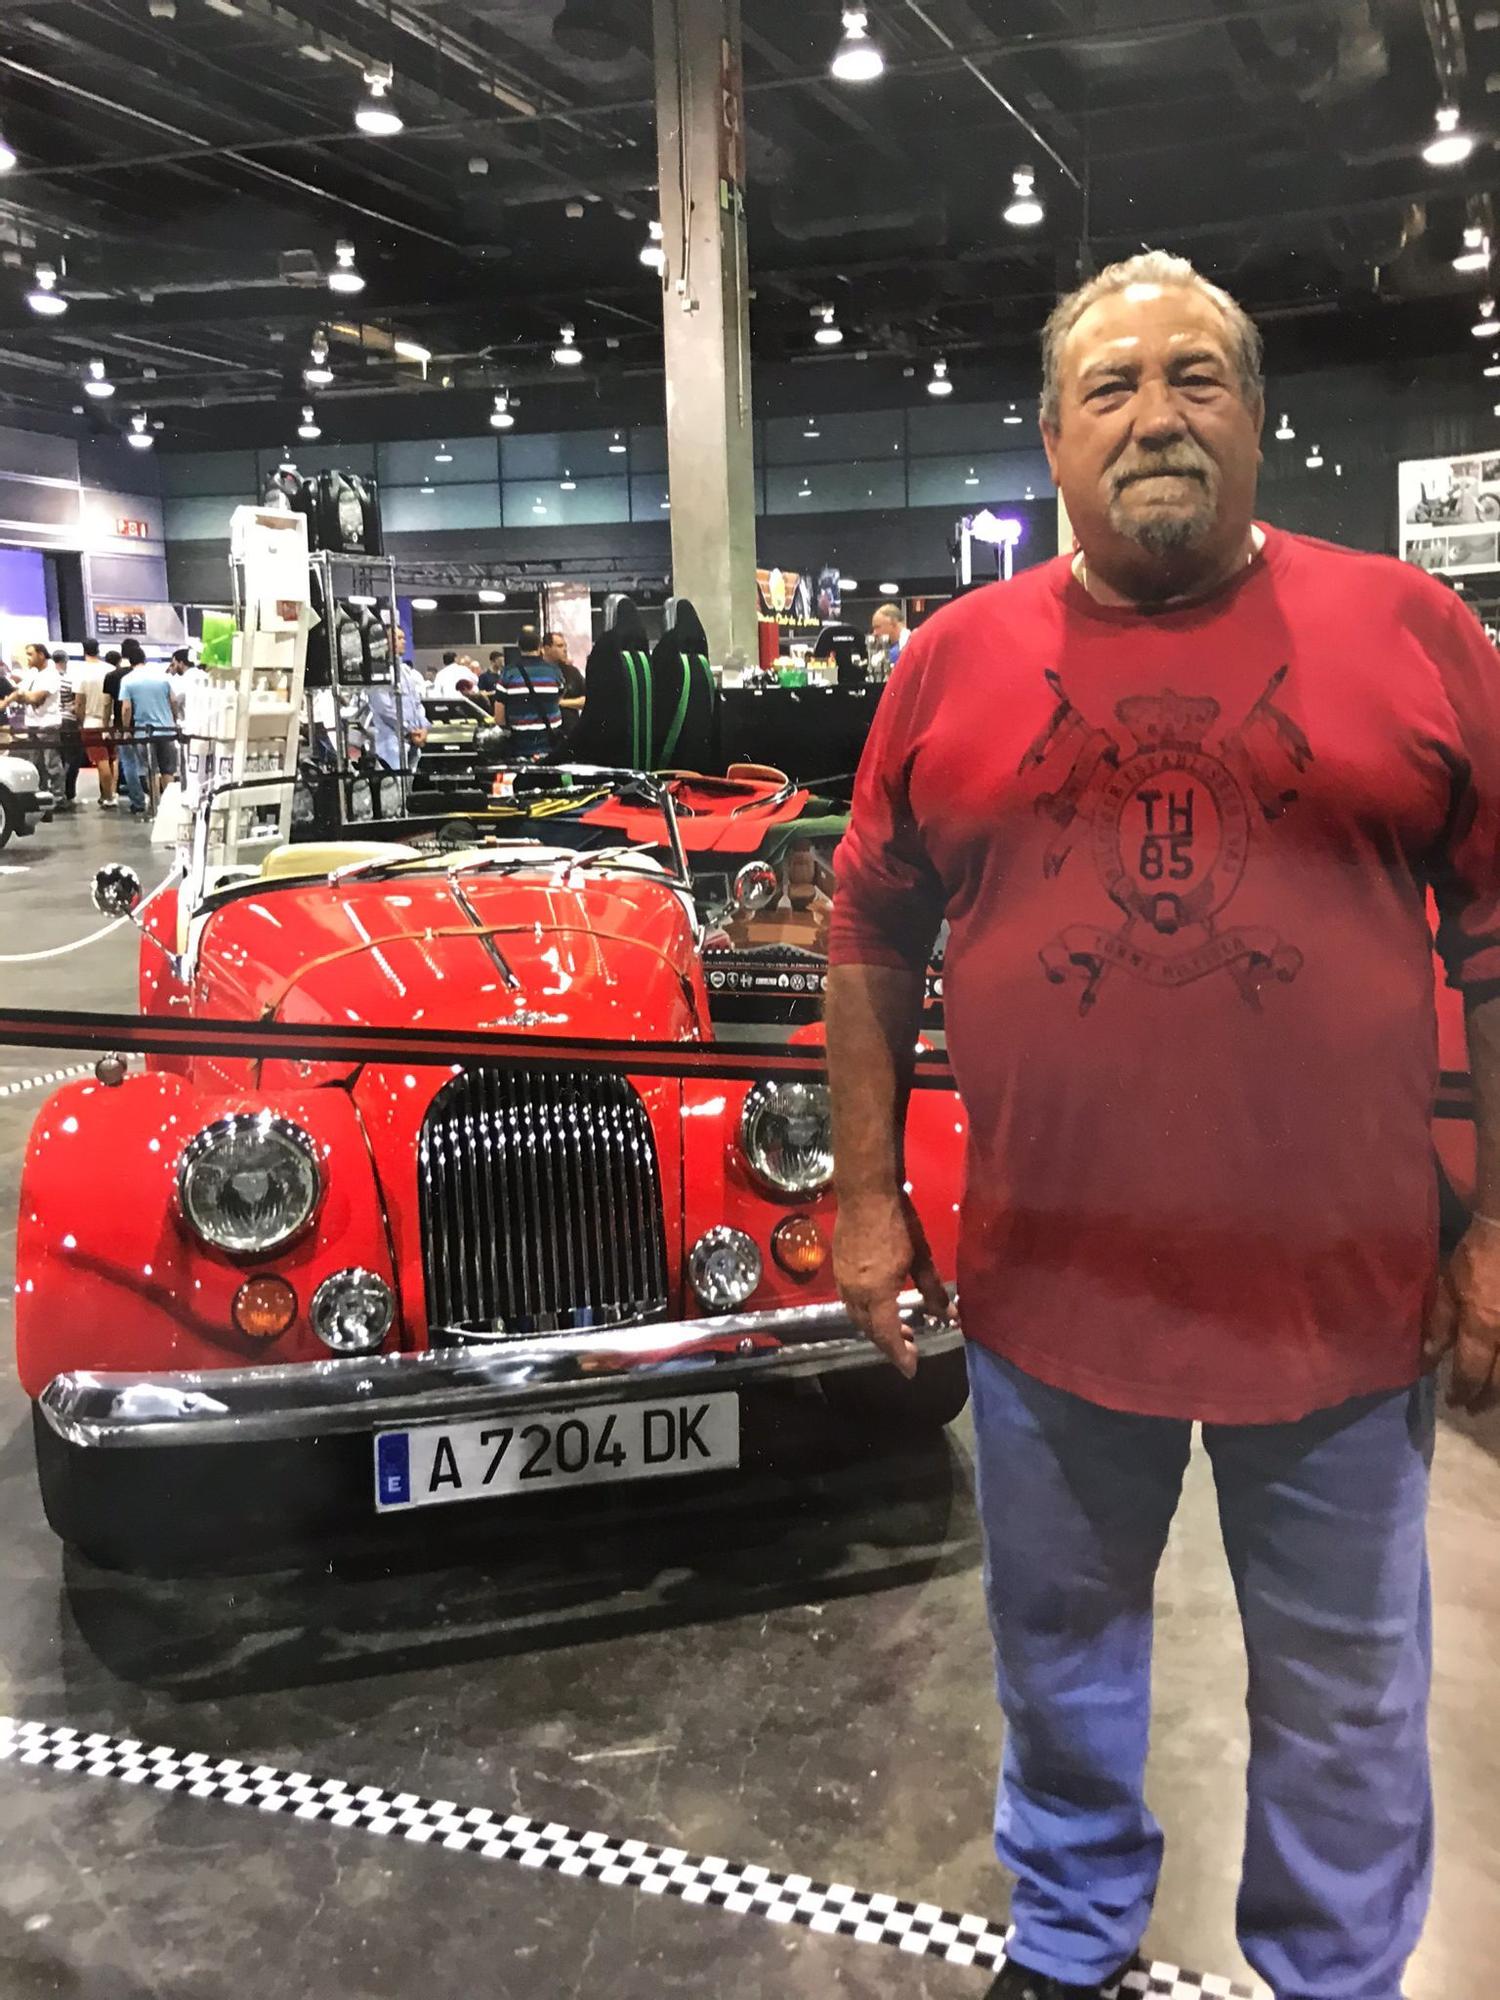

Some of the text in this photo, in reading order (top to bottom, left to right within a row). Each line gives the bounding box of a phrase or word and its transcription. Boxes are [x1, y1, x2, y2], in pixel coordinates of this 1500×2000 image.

[1136, 788, 1193, 836] TH
[1140, 834, 1193, 880] 85
[428, 1404, 712, 1492] A 7204 DK
[388, 1475, 402, 1493] E
